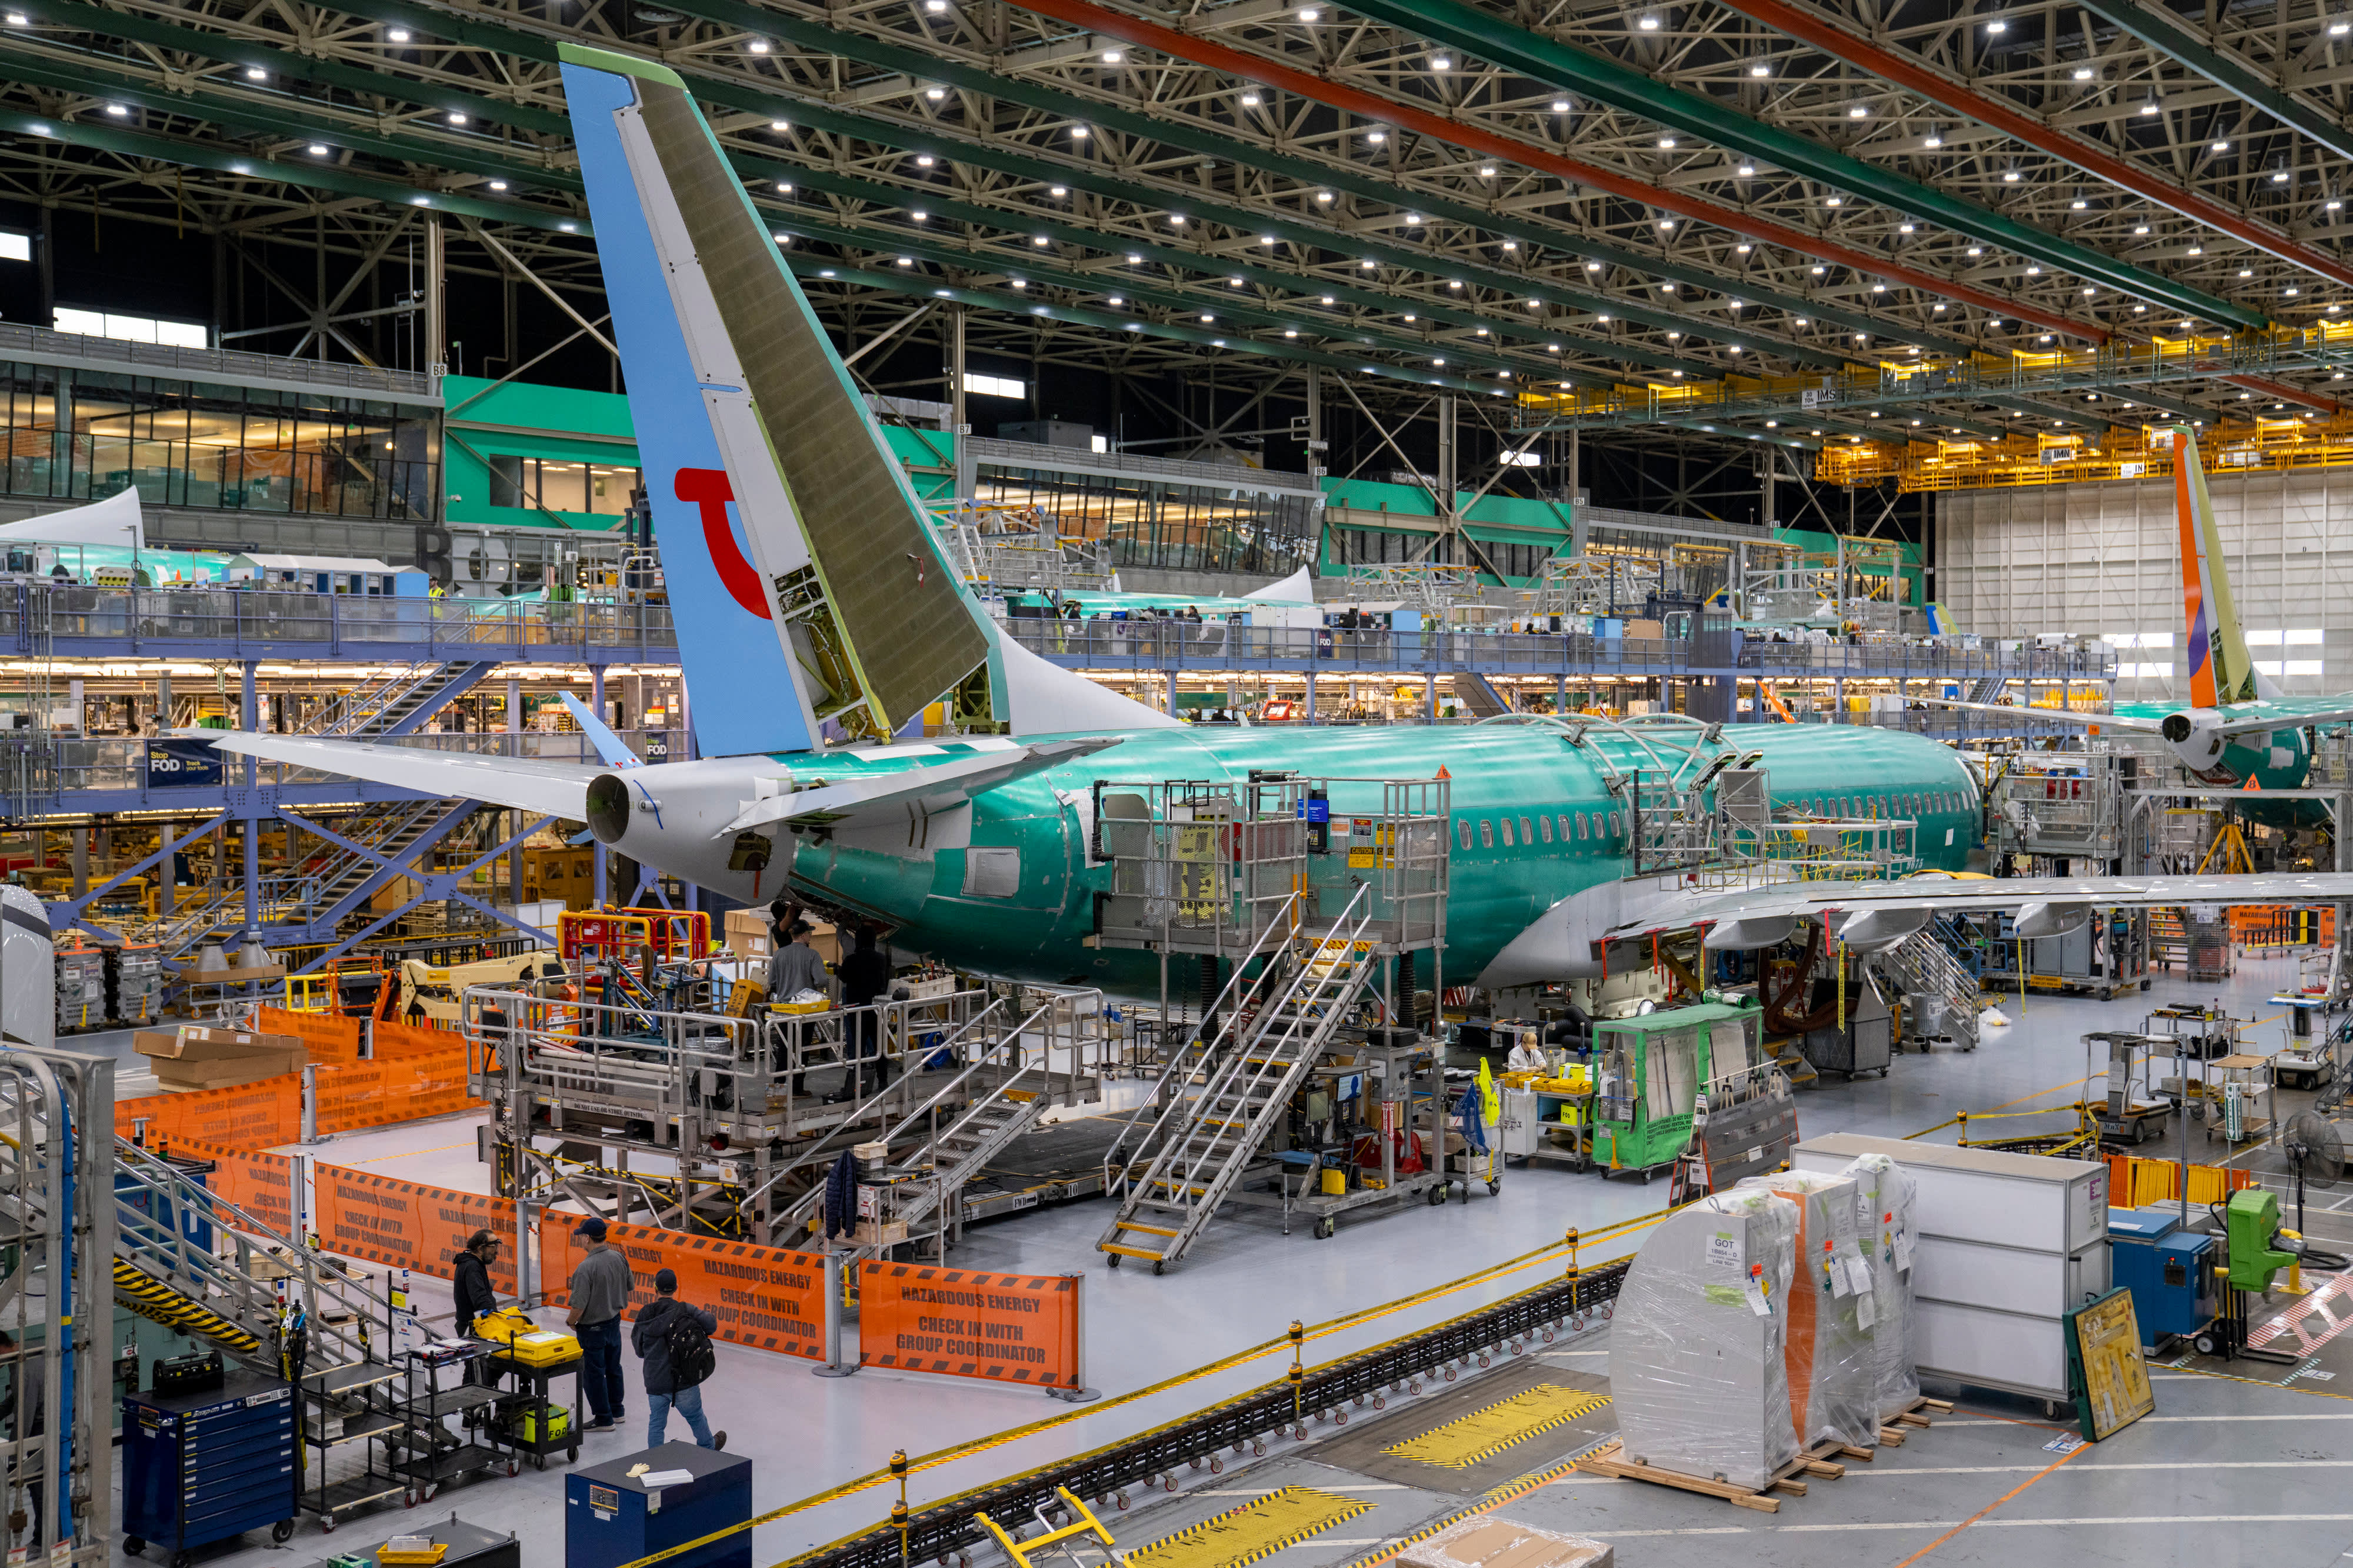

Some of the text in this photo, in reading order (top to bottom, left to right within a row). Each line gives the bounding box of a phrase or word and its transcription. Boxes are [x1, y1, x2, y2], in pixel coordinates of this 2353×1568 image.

[434, 365, 445, 375] B8
[960, 425, 969, 434] B7
[647, 745, 667, 755] FOD
[151, 759, 180, 772] FOD
[2248, 780, 2255, 789] 8
[1896, 831, 1906, 846] 29
[608, 1107, 624, 1116] STORE
[248, 1168, 287, 1187] HAZARDOUS
[1069, 1184, 1077, 1197] 10
[254, 1192, 277, 1208] CHECK
[336, 1185, 408, 1213] HAZARDOUS ENERGY
[1014, 1197, 1026, 1208] FWD
[243, 1206, 268, 1221] GROUP
[438, 1207, 517, 1235] HAZARDOUS ENERG
[345, 1210, 403, 1235] CHECK IN WITH
[335, 1224, 413, 1255] GROUP COORDINATOR
[1715, 1239, 1734, 1249] GOT
[628, 1246, 662, 1265] ENERGY
[704, 1259, 811, 1290] HAZARDOUS ENERGY
[721, 1287, 799, 1316] CHECK IN WITH
[901, 1286, 1040, 1313] HAZARDOUS ENERGY
[704, 1303, 816, 1339] GROUP COORDINATOR
[918, 1316, 1024, 1341] CHECK IN WITH
[896, 1334, 1046, 1364] GROUP COORDINATOR
[549, 1427, 566, 1439] FOD
[836, 1484, 850, 1492] Caution
[738, 1520, 753, 1529] Caution
[988, 1530, 1013, 1562] MAXIMUM SPEED
[631, 1559, 647, 1568] Caution
